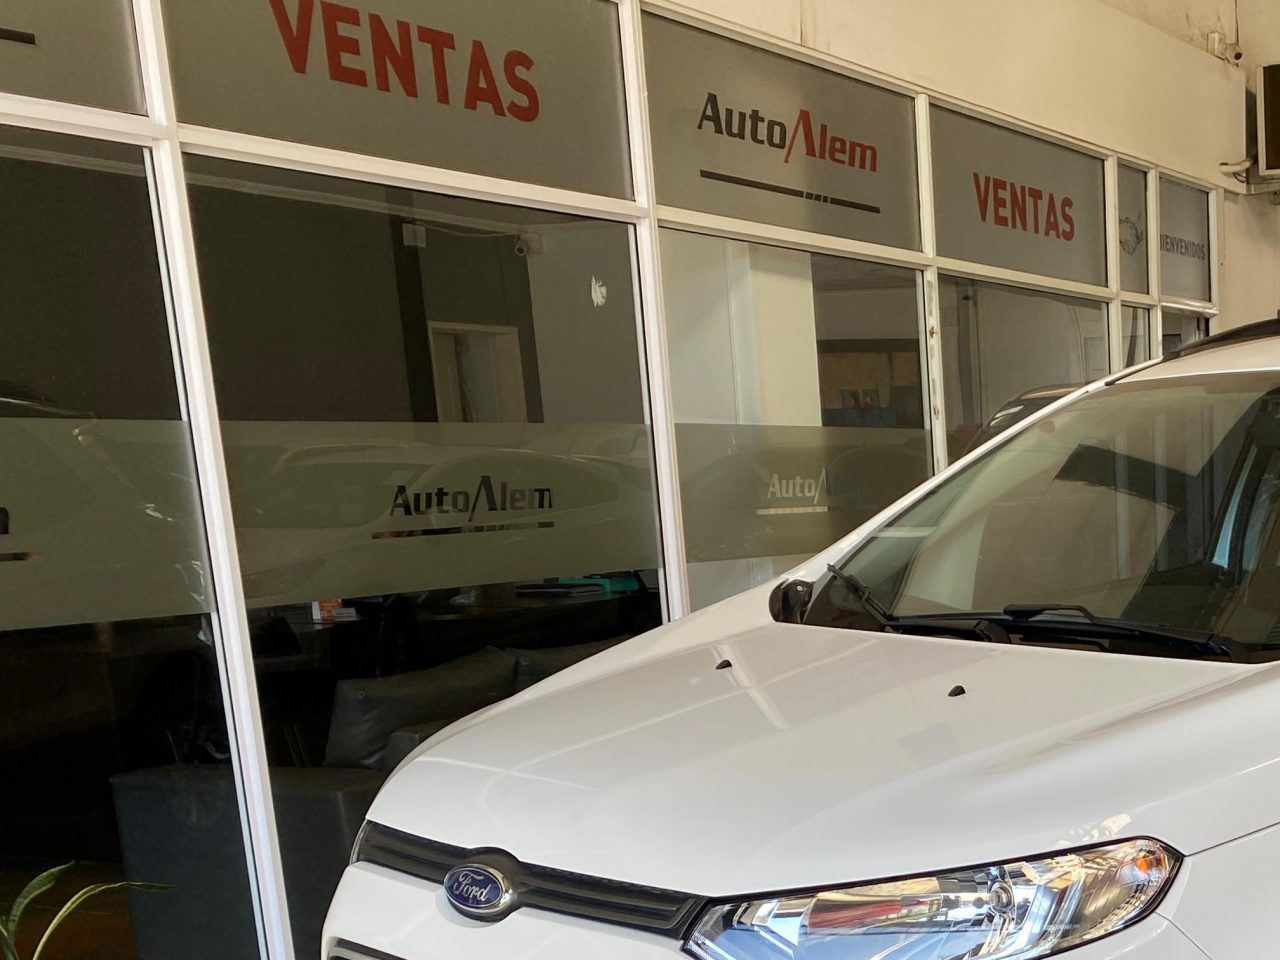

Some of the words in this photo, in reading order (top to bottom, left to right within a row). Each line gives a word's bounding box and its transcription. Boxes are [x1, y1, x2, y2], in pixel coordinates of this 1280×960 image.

[269, 0, 540, 123] VENTAS
[972, 171, 1075, 242] VENTAS
[453, 871, 492, 902] Ford
